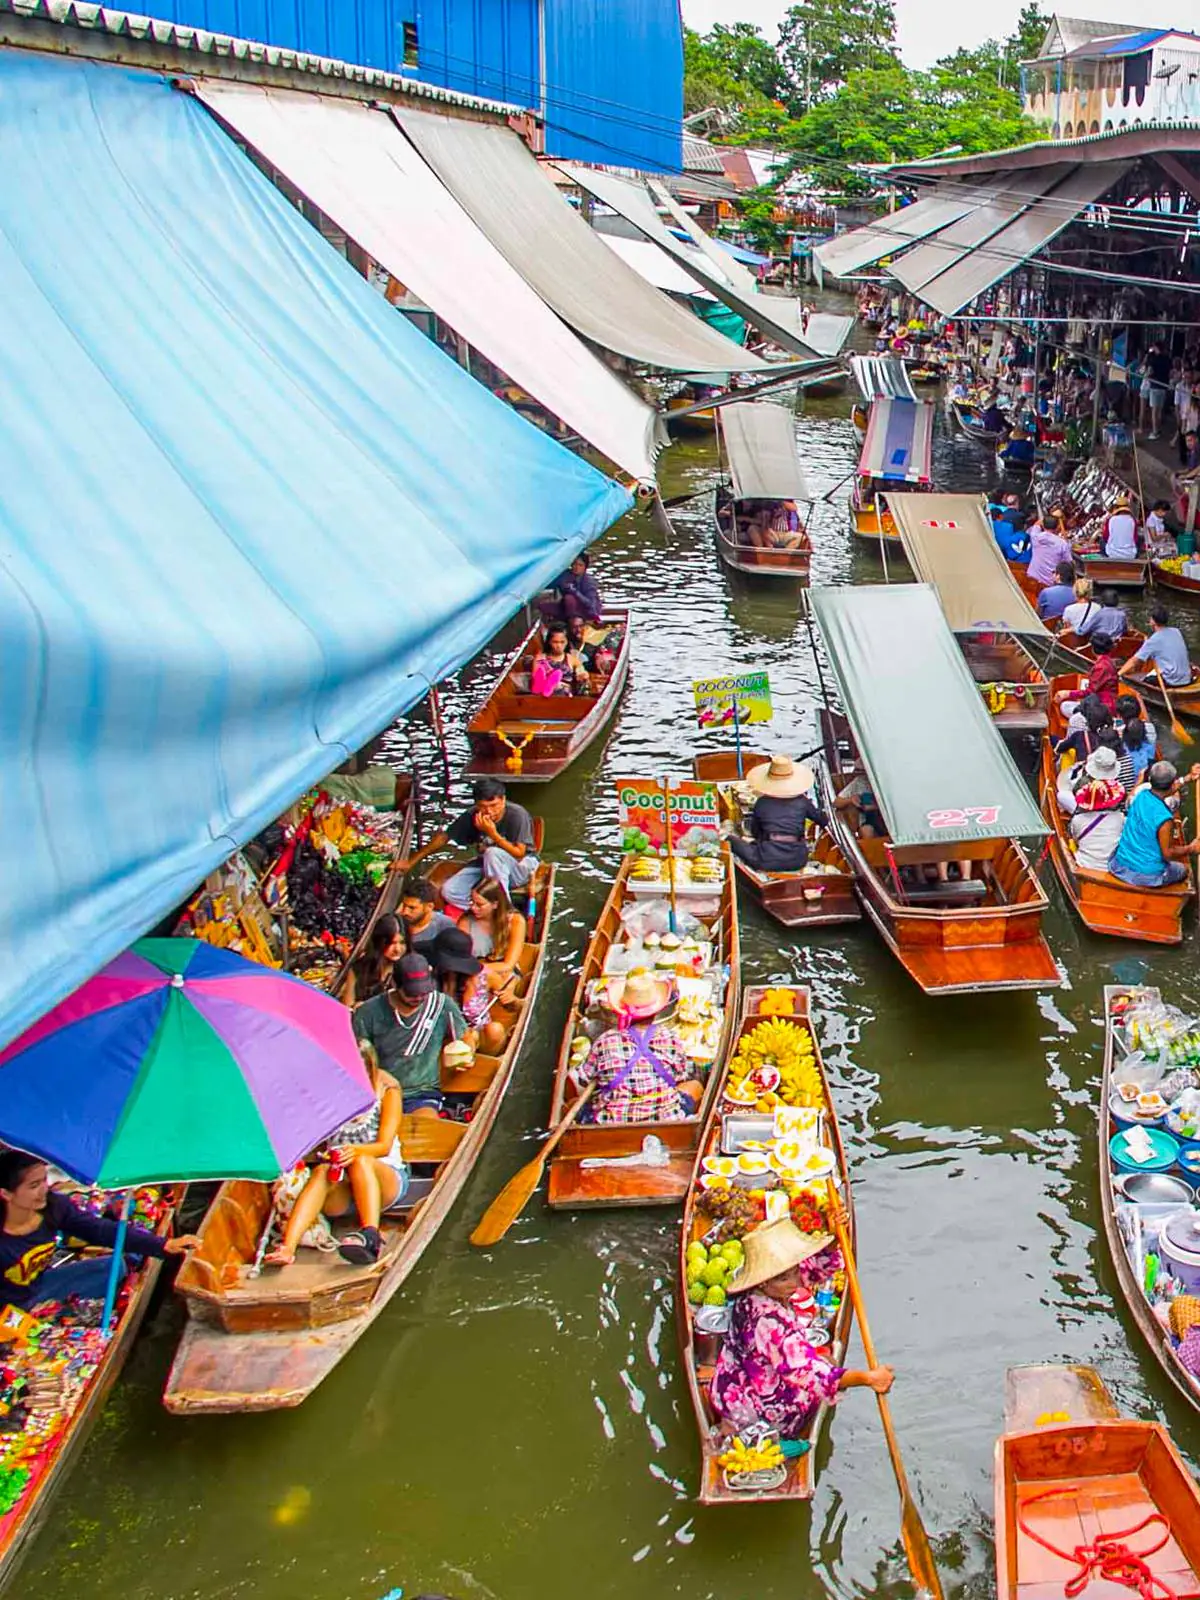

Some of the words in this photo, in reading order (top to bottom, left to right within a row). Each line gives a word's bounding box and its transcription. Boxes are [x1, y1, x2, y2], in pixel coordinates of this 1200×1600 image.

[696, 676, 764, 694] COCONUT
[681, 813, 716, 823] Cream
[927, 805, 1003, 829] 27
